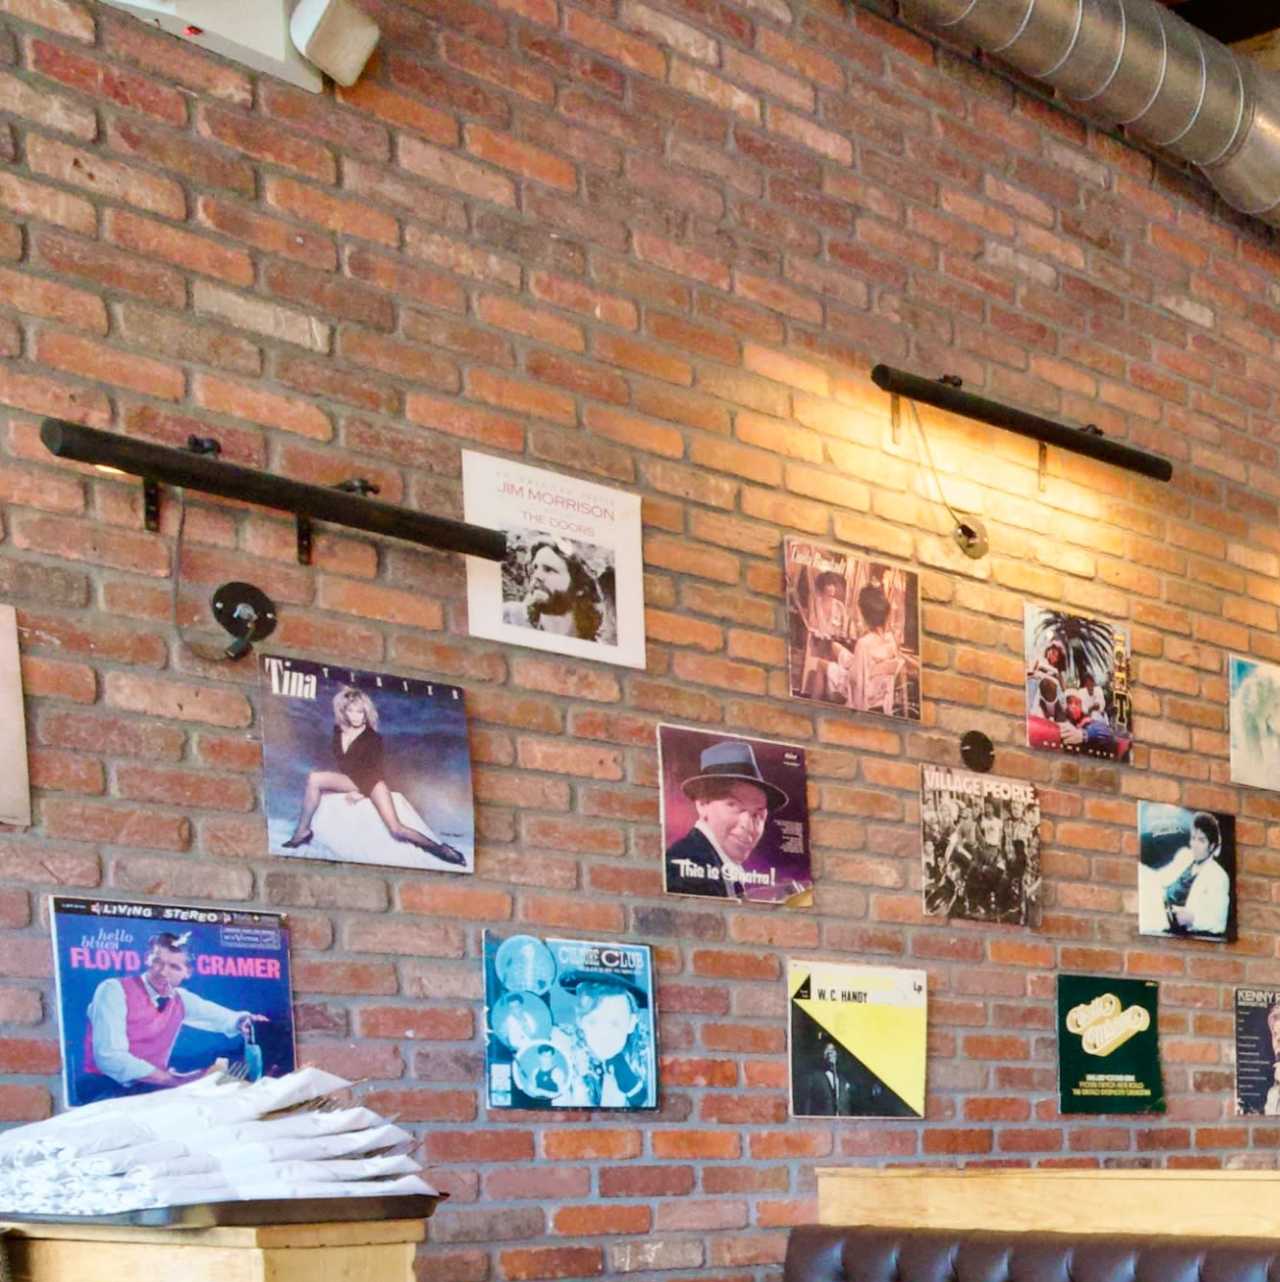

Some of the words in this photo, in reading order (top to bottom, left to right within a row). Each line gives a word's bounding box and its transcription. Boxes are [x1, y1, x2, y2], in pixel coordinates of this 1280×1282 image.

[497, 480, 524, 498] JIM
[528, 487, 616, 522] MORRISON
[264, 656, 318, 700] Tina
[922, 768, 981, 797] VILLAGE
[983, 781, 1035, 804] PEOPLE
[671, 858, 705, 880] This
[706, 864, 720, 880] is
[102, 903, 153, 918] LIVING
[162, 907, 218, 923] STEREO
[97, 928, 134, 944] hello
[70, 946, 141, 972] FLOYD
[197, 953, 281, 980] CRAMER
[601, 949, 645, 969] CLUB
[841, 991, 868, 1004] HANDY
[1237, 991, 1274, 1004] KENNY
